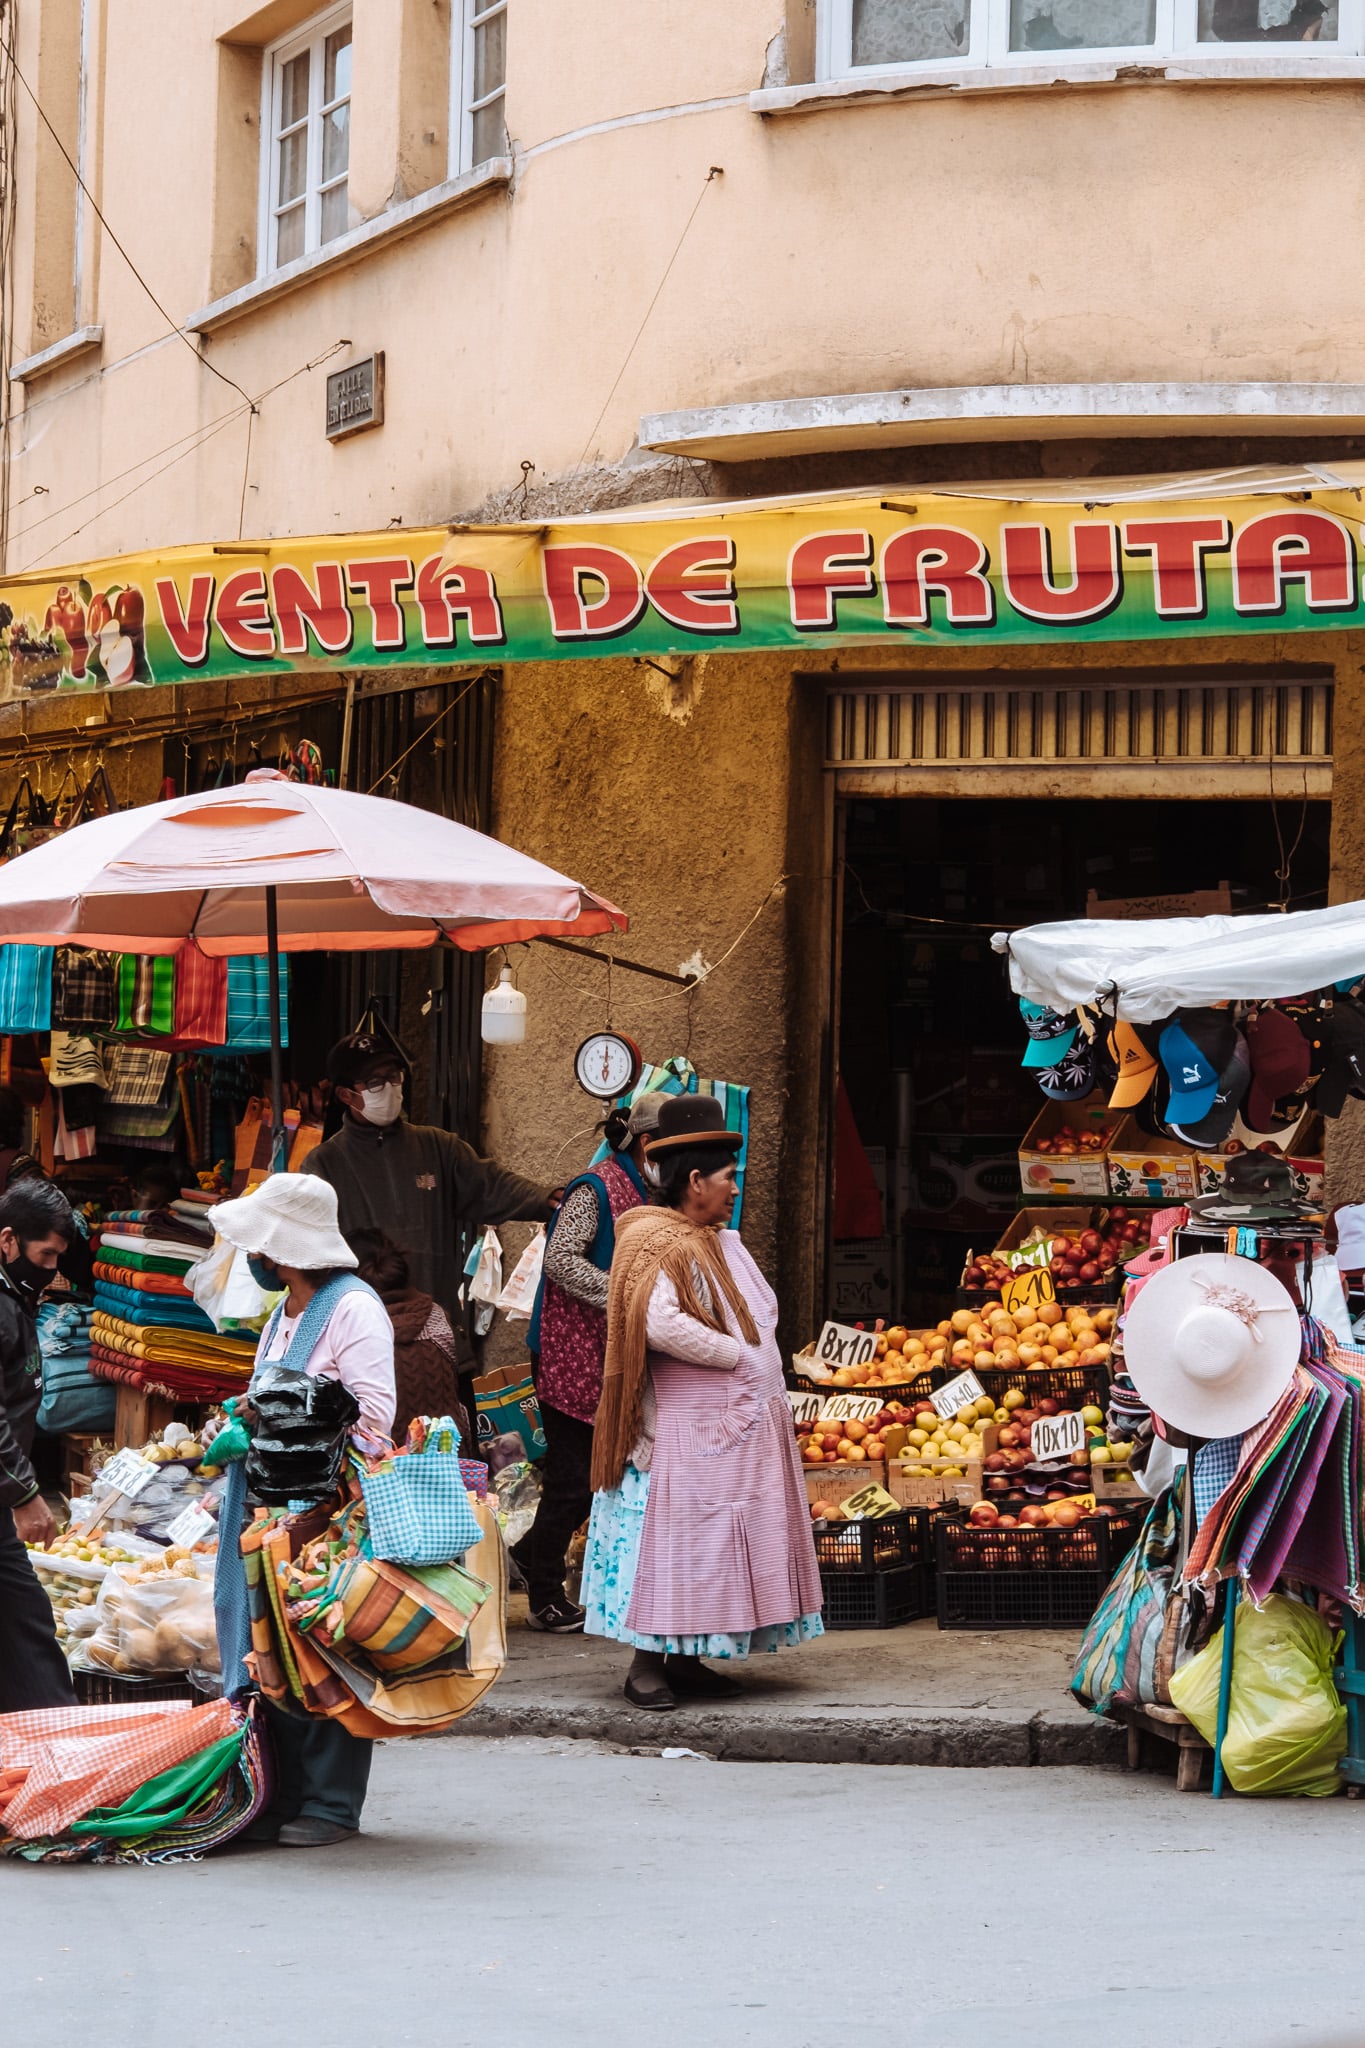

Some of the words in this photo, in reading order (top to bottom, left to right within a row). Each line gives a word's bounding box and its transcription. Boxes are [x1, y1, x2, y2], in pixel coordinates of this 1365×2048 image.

[155, 554, 502, 667] VENTA
[541, 535, 739, 641] DE
[786, 508, 1365, 632] FRUTA
[821, 1327, 873, 1366] 8x10
[788, 1396, 819, 1422] x10
[826, 1398, 878, 1420] 10x10
[1034, 1415, 1079, 1465] 10x10
[848, 1486, 892, 1517] 6x1
